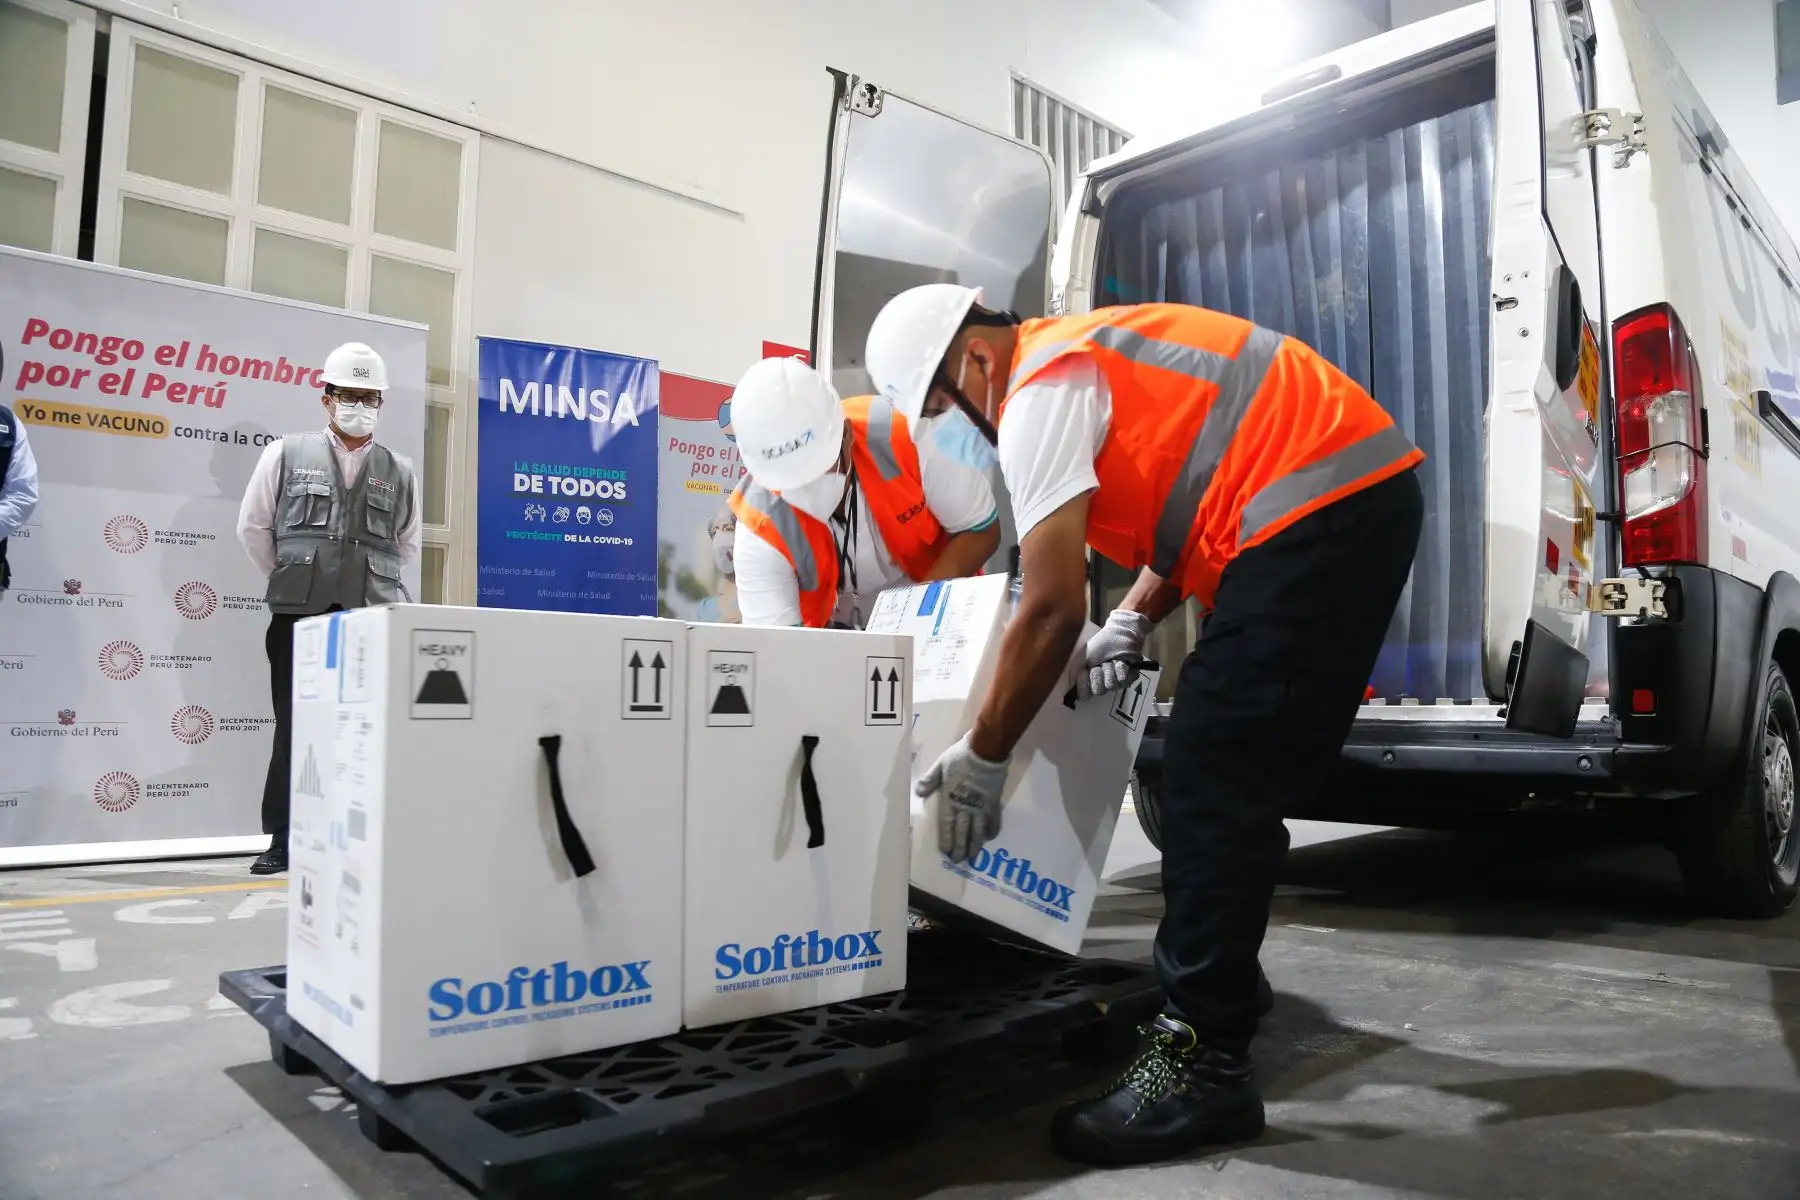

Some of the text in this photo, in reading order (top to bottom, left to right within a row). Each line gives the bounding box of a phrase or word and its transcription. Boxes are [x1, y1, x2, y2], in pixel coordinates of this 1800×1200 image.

[21, 318, 145, 367] Pongo
[154, 340, 191, 368] el
[15, 359, 228, 409] por el Perú
[499, 378, 640, 427] MINSA
[22, 403, 165, 435] Yo me VACUNO
[174, 425, 230, 444] contra
[233, 429, 249, 446] la
[669, 437, 715, 460] Pongo
[720, 446, 732, 460] el
[514, 461, 627, 480] LA SALUD DEPENDE
[691, 462, 718, 477] por
[721, 464, 734, 479] el
[513, 473, 627, 500] DE TODOS
[155, 530, 216, 540] BICENTENARIO
[155, 536, 176, 545] PERÚ
[506, 530, 633, 545] PROTÉGETE DE LA COVID-19
[479, 565, 556, 577] Ministerio de Salud
[587, 571, 656, 582] Ministerio de Salud
[17, 592, 124, 608] Gobierno del Perú
[537, 589, 611, 600] Ministerio de Salud
[223, 602, 244, 610] PERÚ
[150, 654, 212, 662] BICENTENARIO
[418, 644, 467, 657] HEAVY
[150, 661, 172, 669] PERÚ
[712, 663, 748, 674] HEAVY
[10, 726, 119, 737] Gobierno del Perú
[146, 782, 209, 790] BICENTENARIO
[146, 789, 169, 797] PERÚ
[966, 847, 1076, 912] oftbox
[714, 929, 883, 980] Softbox
[716, 964, 851, 994] TEMPERATURE CONTROL PACKAGING SYSTEMS
[428, 960, 652, 1022] Softbox
